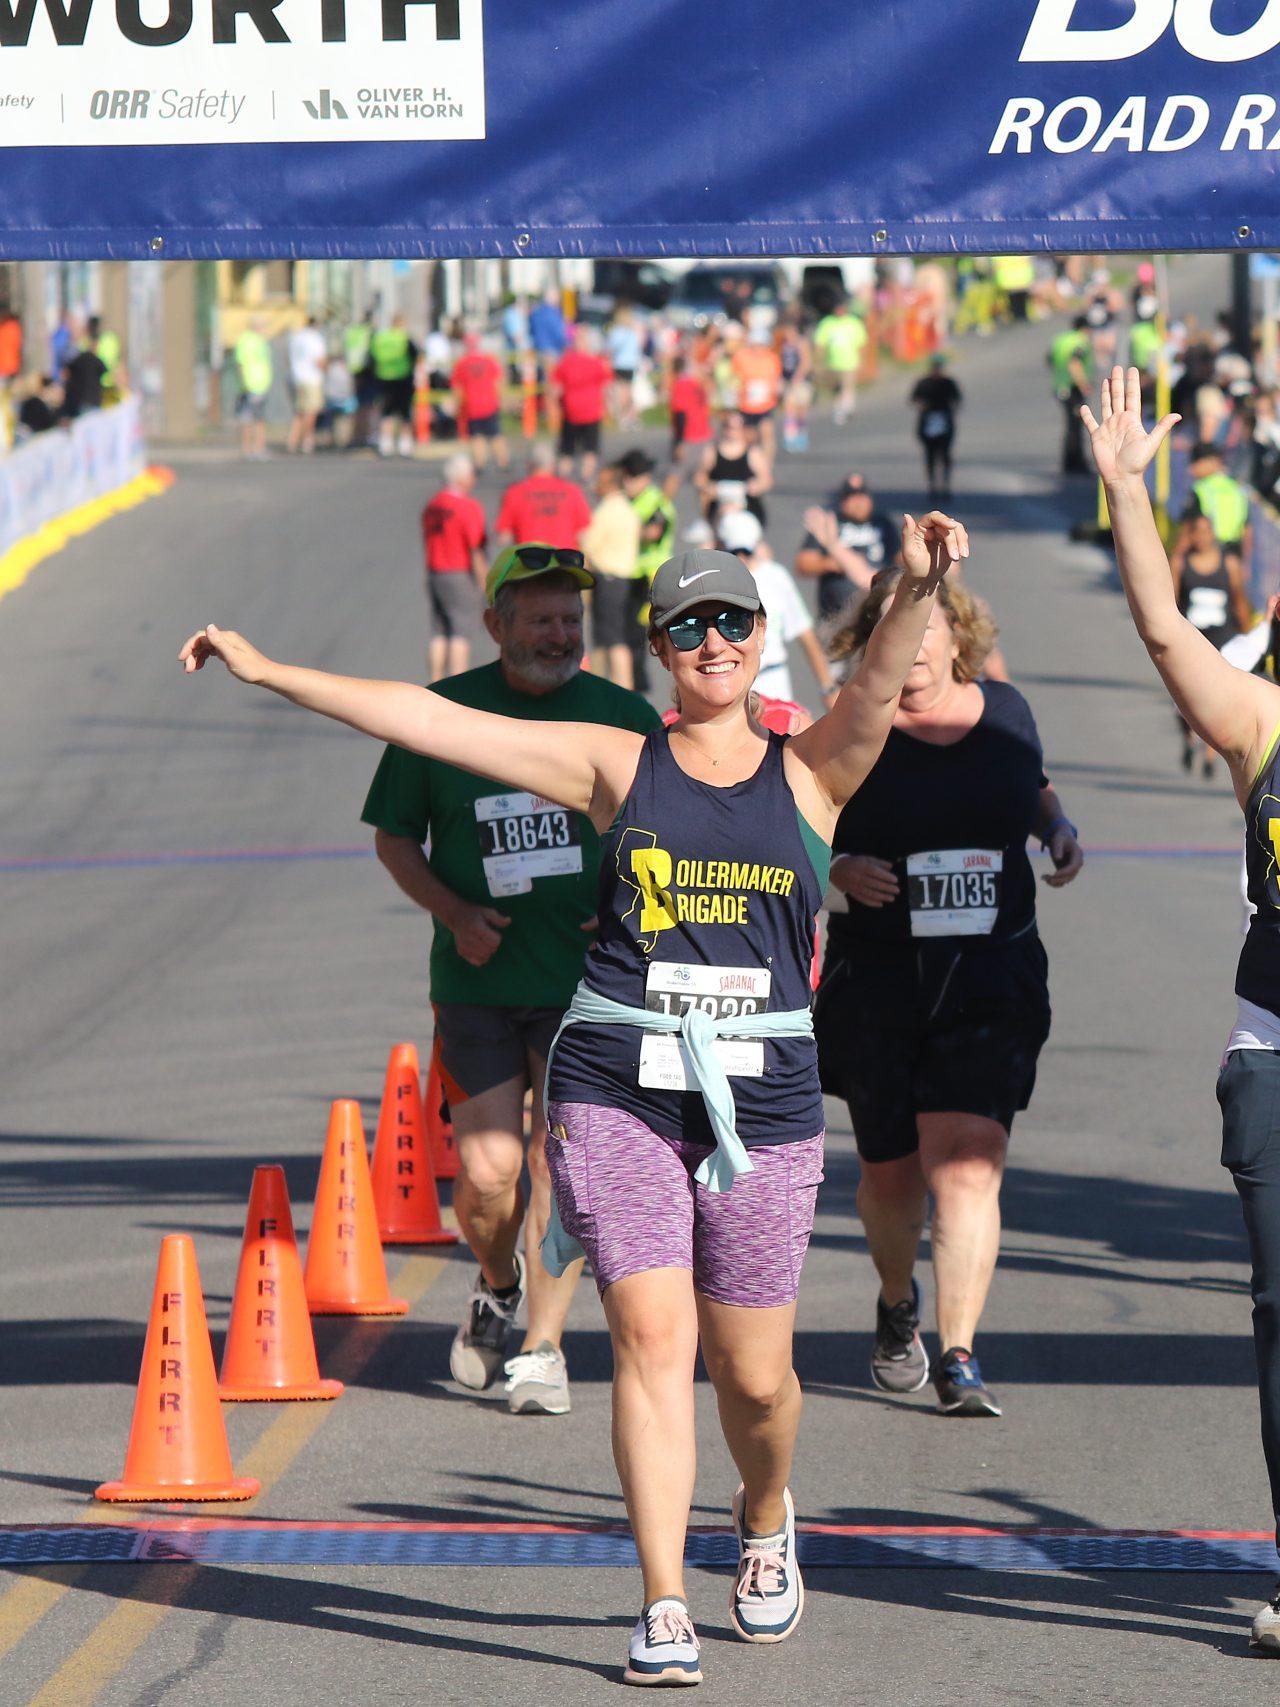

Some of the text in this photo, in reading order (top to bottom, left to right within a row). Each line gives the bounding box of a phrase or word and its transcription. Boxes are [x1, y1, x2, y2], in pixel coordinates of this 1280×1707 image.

[89, 88, 246, 125] ORR Safety
[356, 87, 452, 103] OLIVER H.
[356, 104, 463, 119] VAN HORN
[988, 95, 1210, 154] ROAD
[487, 812, 570, 854] 18643
[918, 872, 996, 909] 17035
[719, 974, 757, 994] SARANAC
[395, 1083, 417, 1200] FLRRT
[255, 1218, 277, 1356] FLRRT
[158, 1293, 182, 1446] FLRRT
